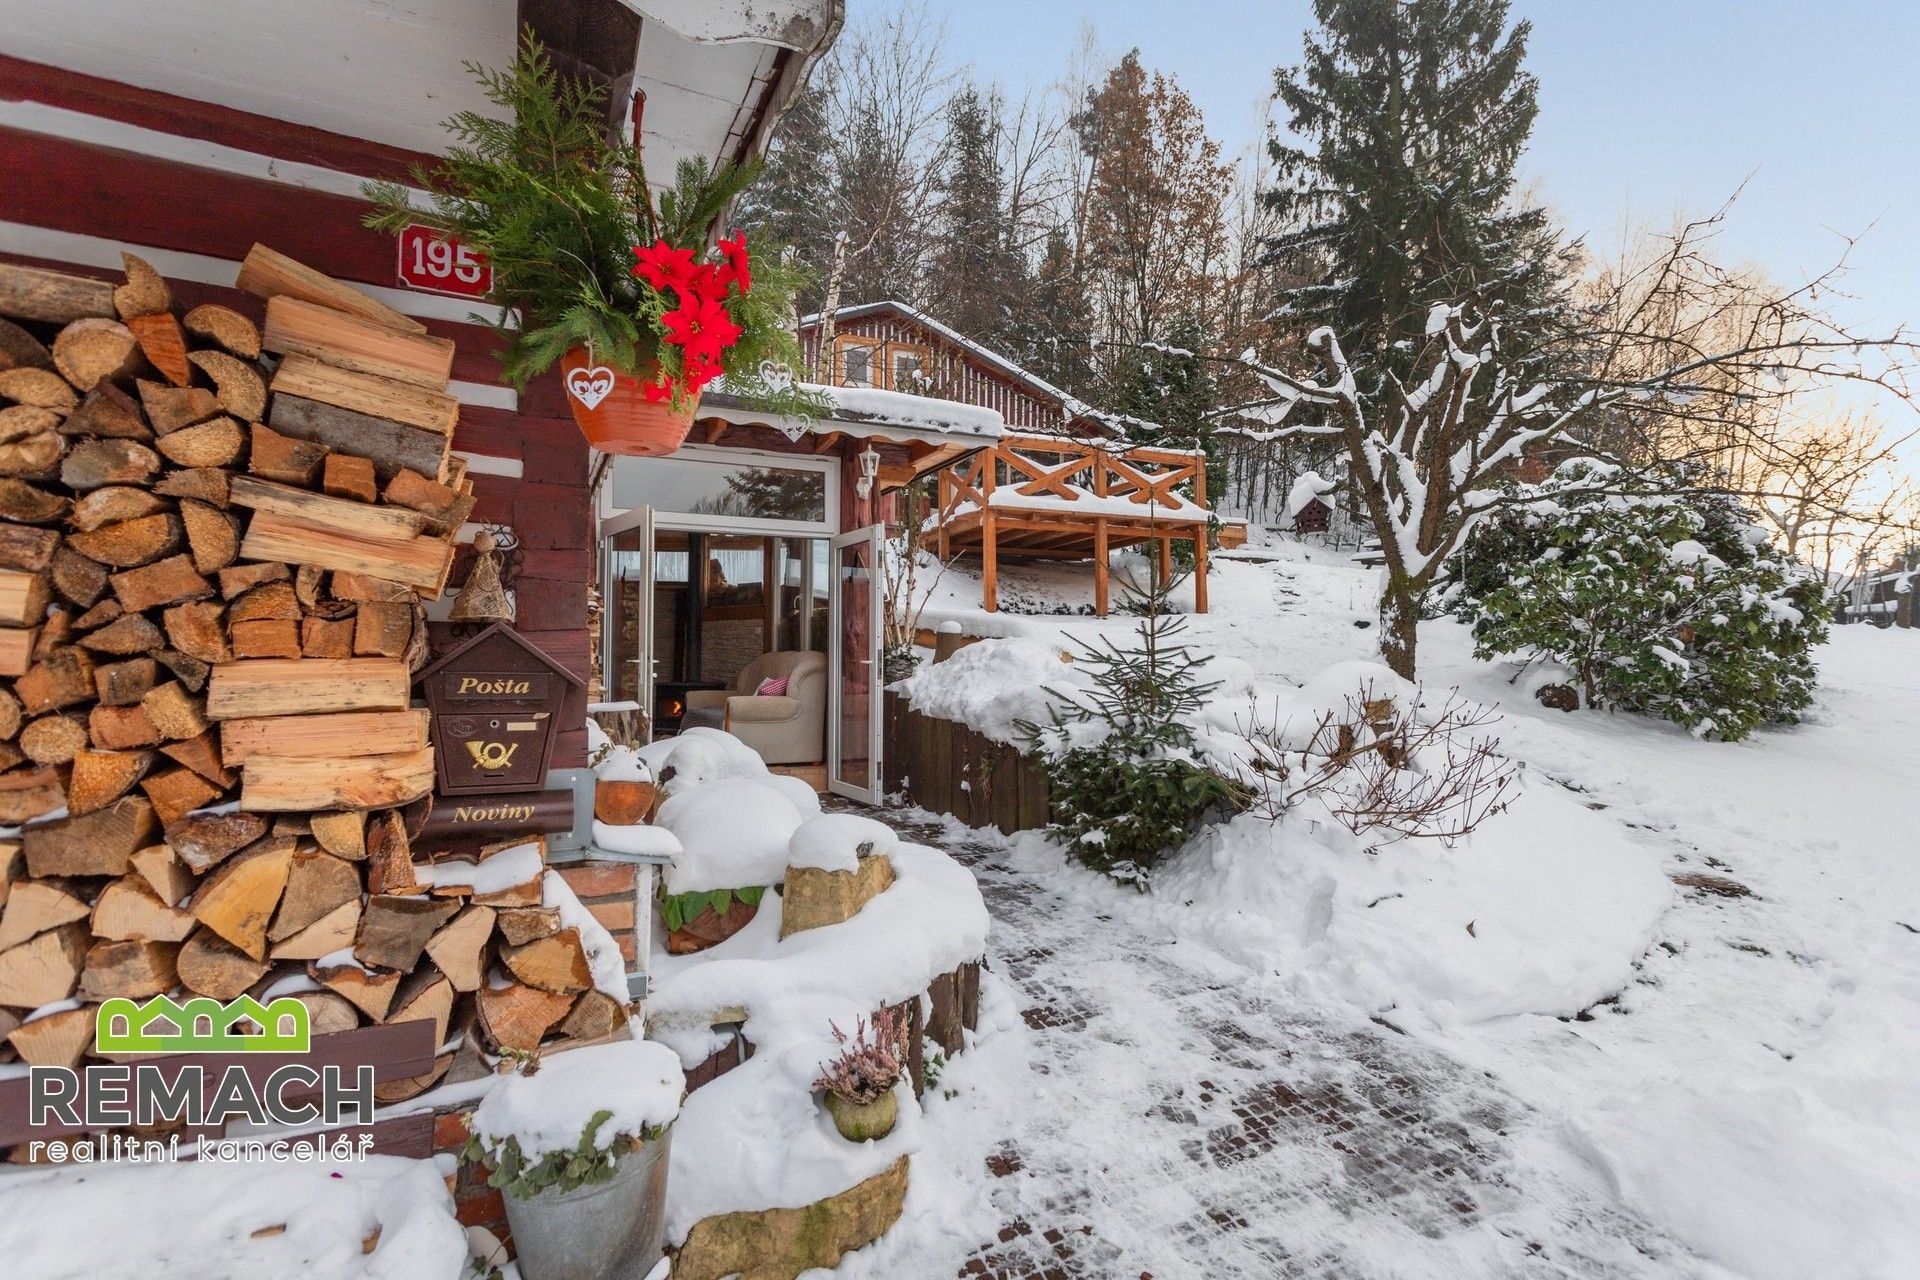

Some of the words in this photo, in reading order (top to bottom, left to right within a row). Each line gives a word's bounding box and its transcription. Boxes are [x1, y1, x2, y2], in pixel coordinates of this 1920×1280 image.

[412, 236, 481, 284] 195
[457, 676, 530, 695] Pošta
[452, 803, 535, 824] Noviny
